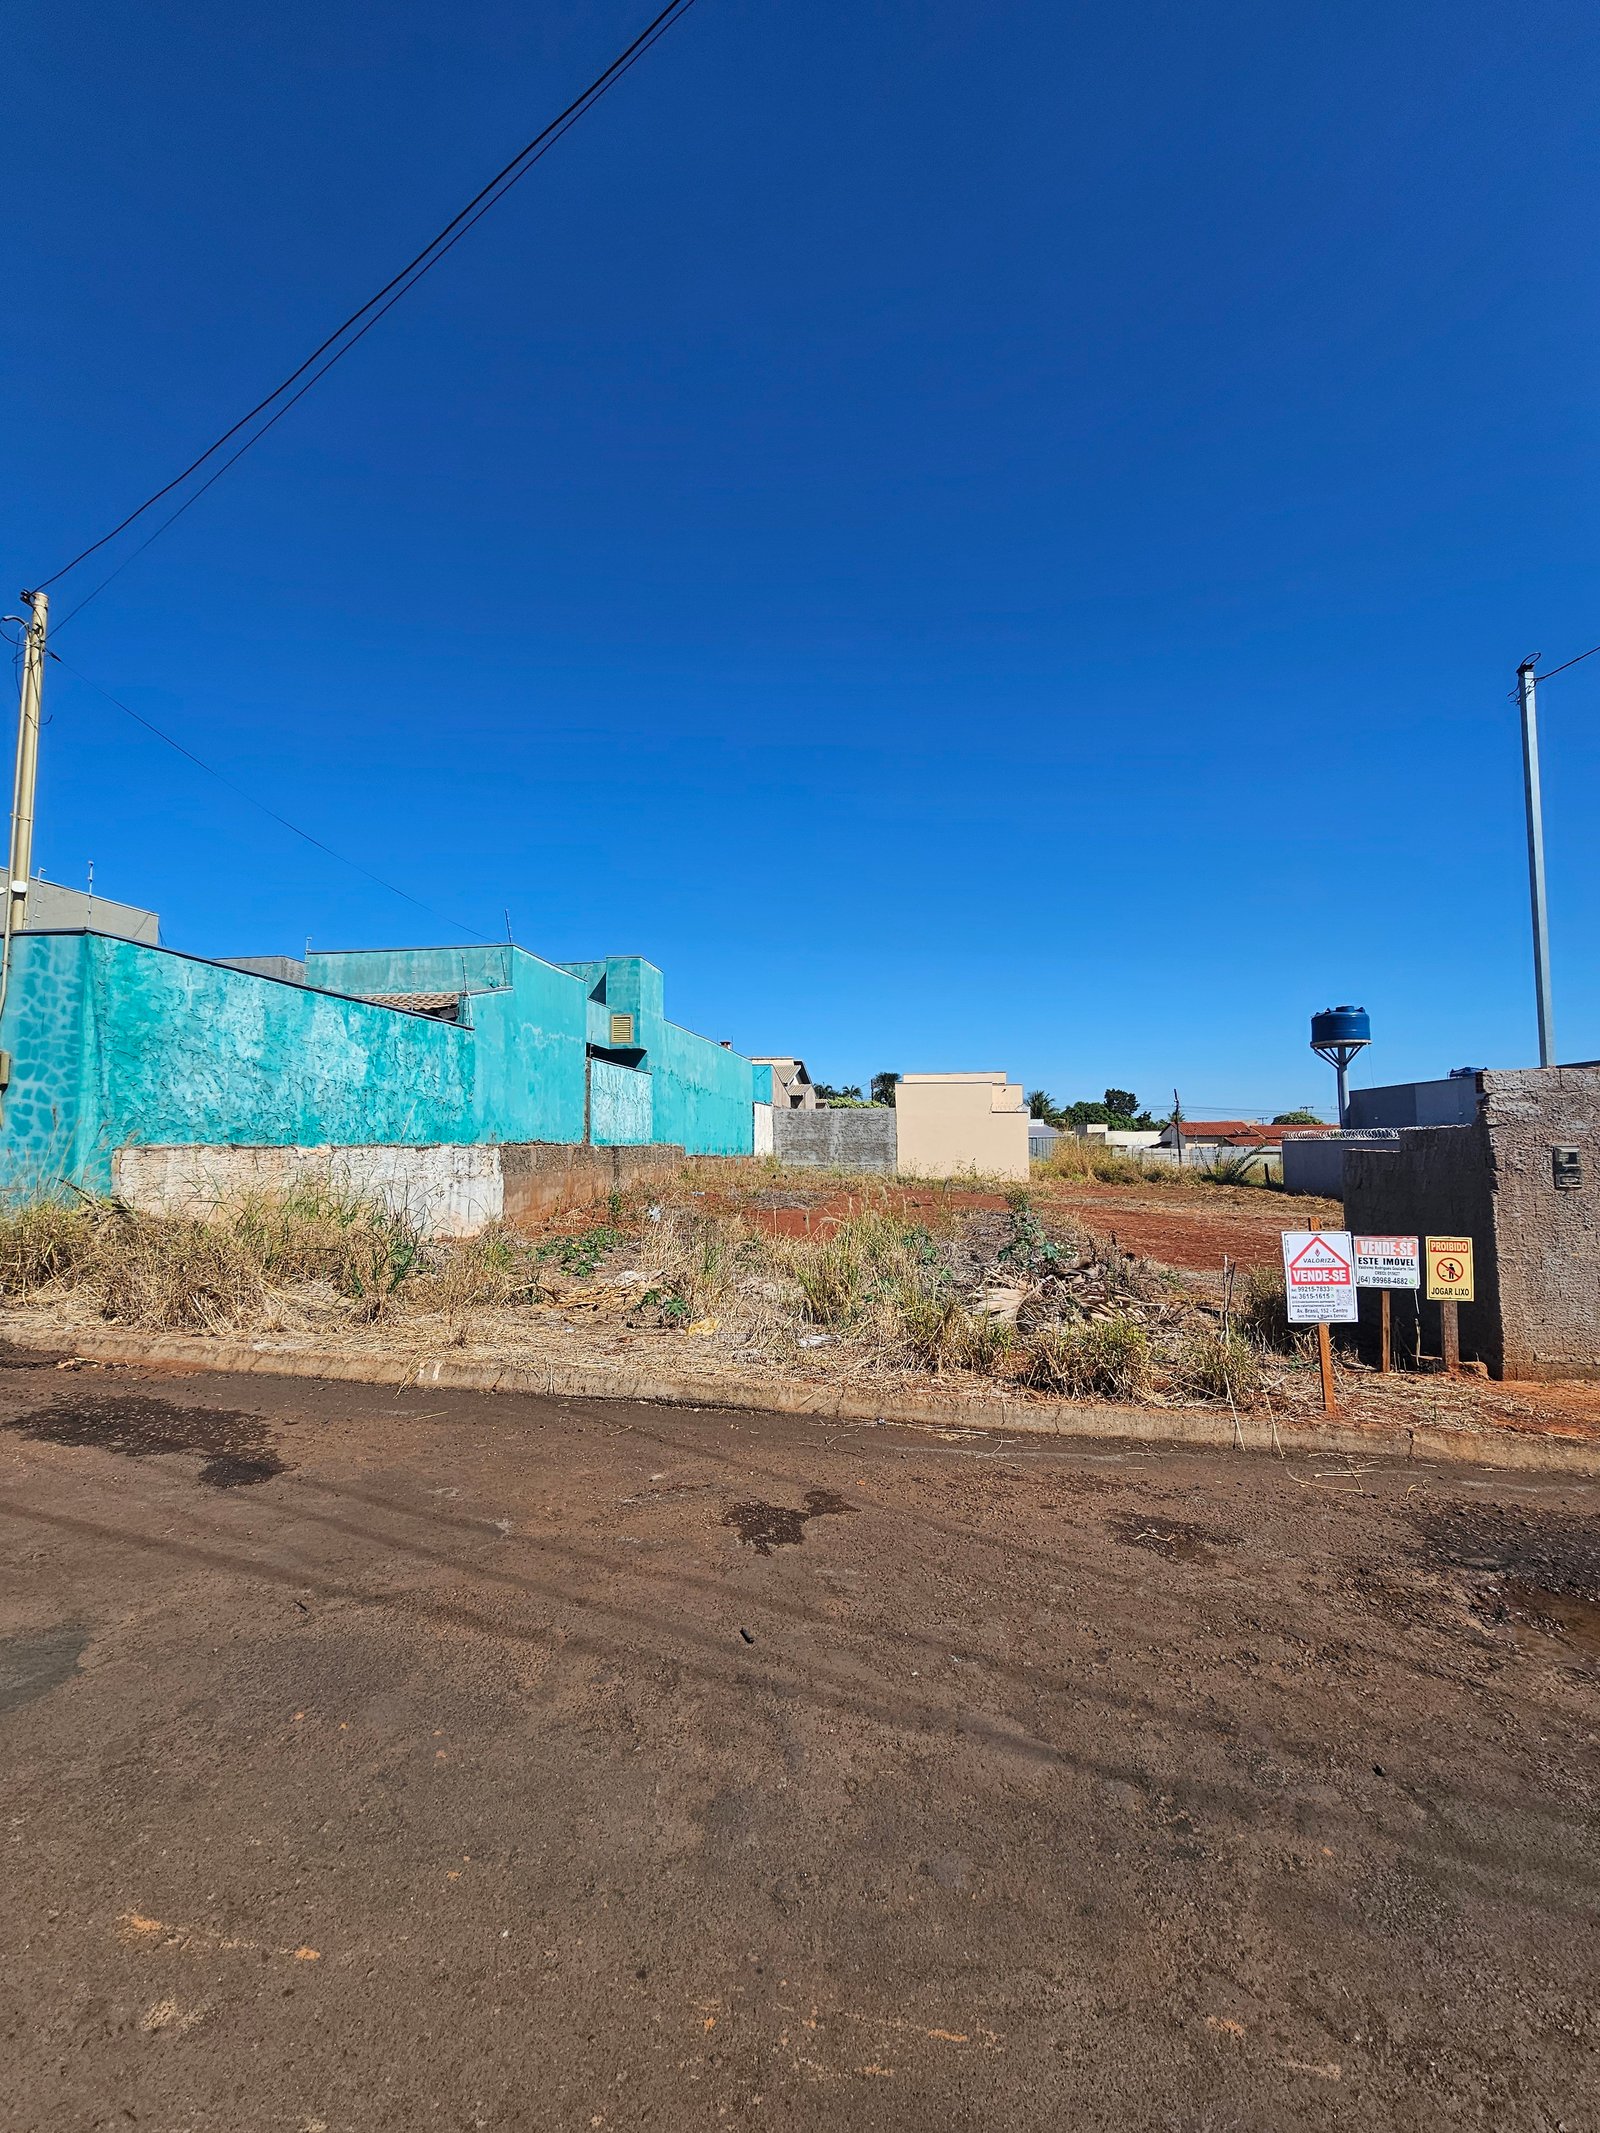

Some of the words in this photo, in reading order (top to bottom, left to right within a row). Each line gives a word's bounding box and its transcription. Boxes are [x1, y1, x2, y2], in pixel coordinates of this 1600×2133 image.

[1360, 1240, 1413, 1255] VENDE-SE
[1431, 1241, 1468, 1252] PROIBIDO
[1358, 1257, 1379, 1265] ESTE
[1383, 1257, 1415, 1267] IMÓVEL
[1292, 1269, 1347, 1282] VENDE-SE
[1358, 1276, 1371, 1285] (64)
[1431, 1287, 1453, 1295] JOGAR
[1454, 1288, 1470, 1296] LIXO
